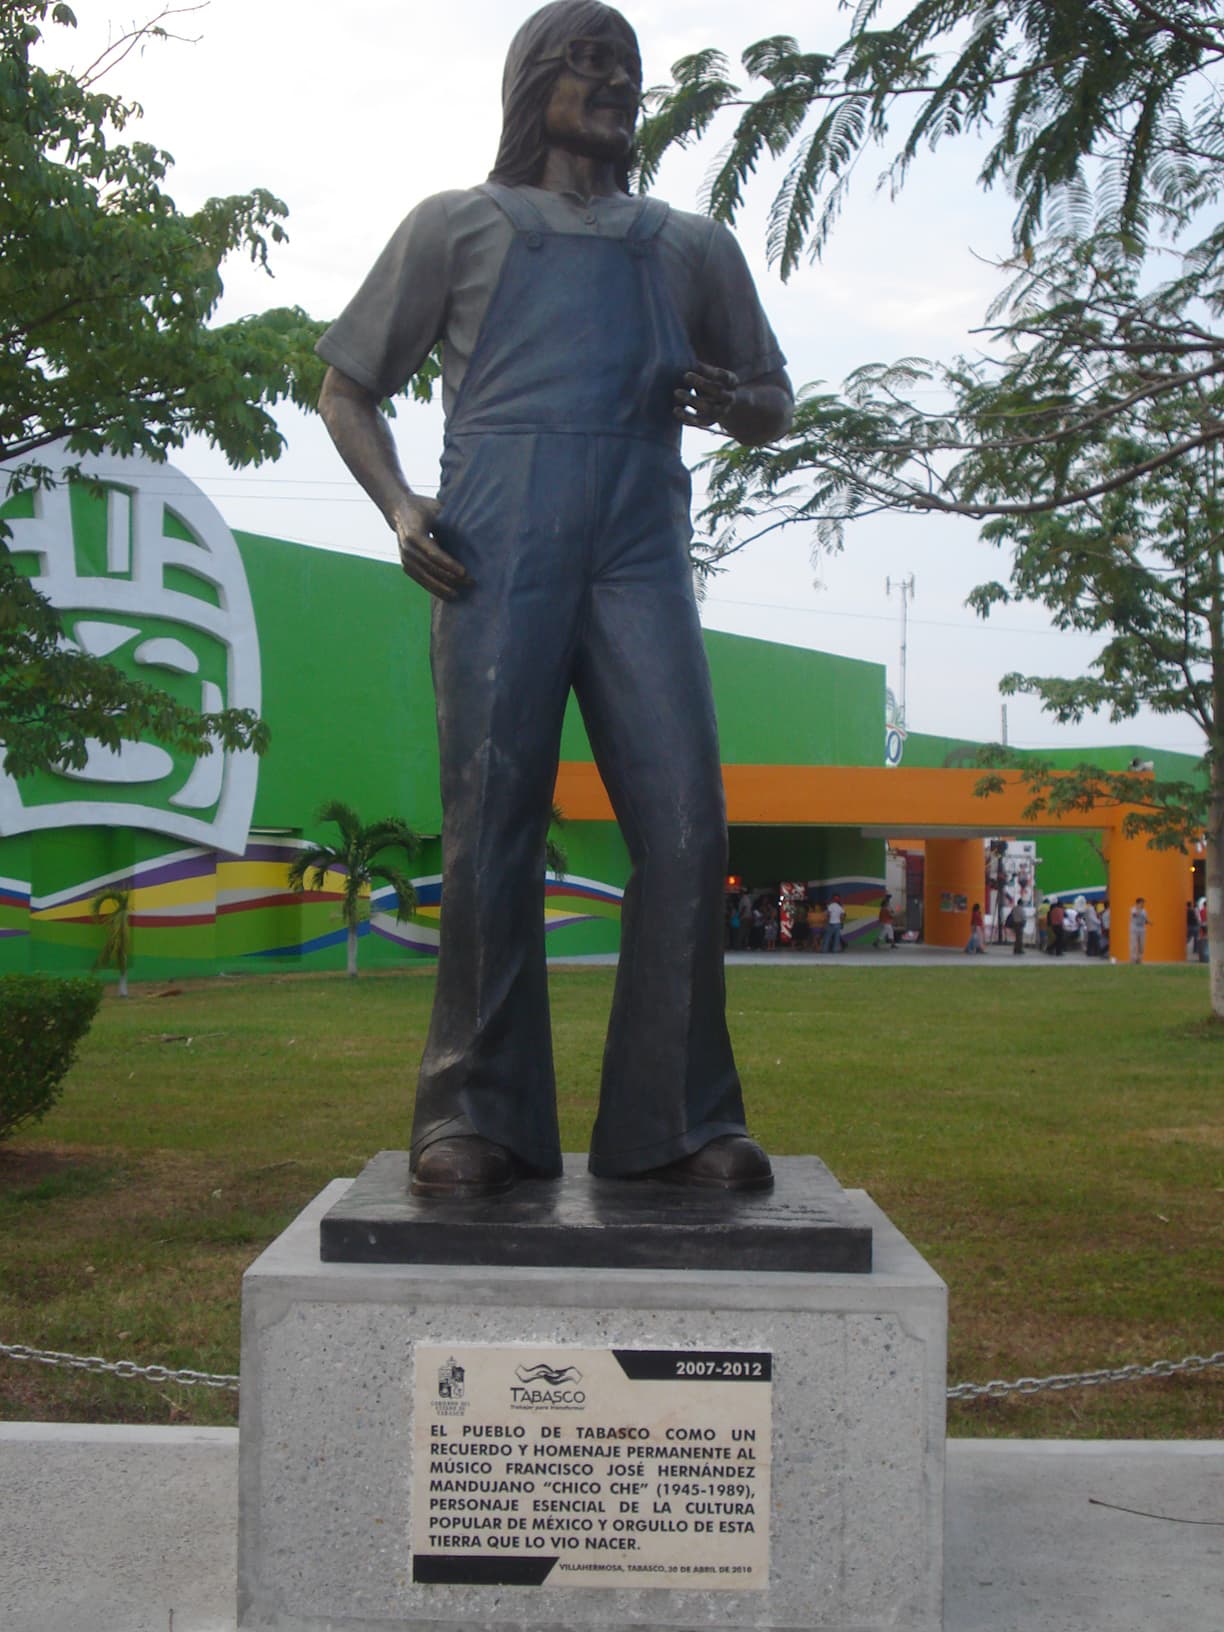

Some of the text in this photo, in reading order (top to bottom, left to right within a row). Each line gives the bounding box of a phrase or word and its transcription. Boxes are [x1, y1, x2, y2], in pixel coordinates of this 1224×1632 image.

[675, 1361, 763, 1377] 2007-2012
[510, 1387, 586, 1404] TABASCO
[430, 1424, 756, 1441] EL PUEBLO DE TABASCO COMO UN
[430, 1443, 756, 1460] RECUERDO Y HOMENAJE PERMANENTE AL
[430, 1457, 756, 1479] MÚSICO FRANCISCO JOSÉ HERNÁNDEZ
[430, 1480, 535, 1493] MANDUJANO
[656, 1484, 755, 1499] (1945-1989),
[430, 1498, 755, 1515] PERSONAJE ESENCIAL DE LA CULTURA
[429, 1515, 755, 1534] POPULAR DE MÉXICO Y ORGULLO DE ESTA
[429, 1535, 641, 1550] TIERRA QUE LO VIO NACER.
